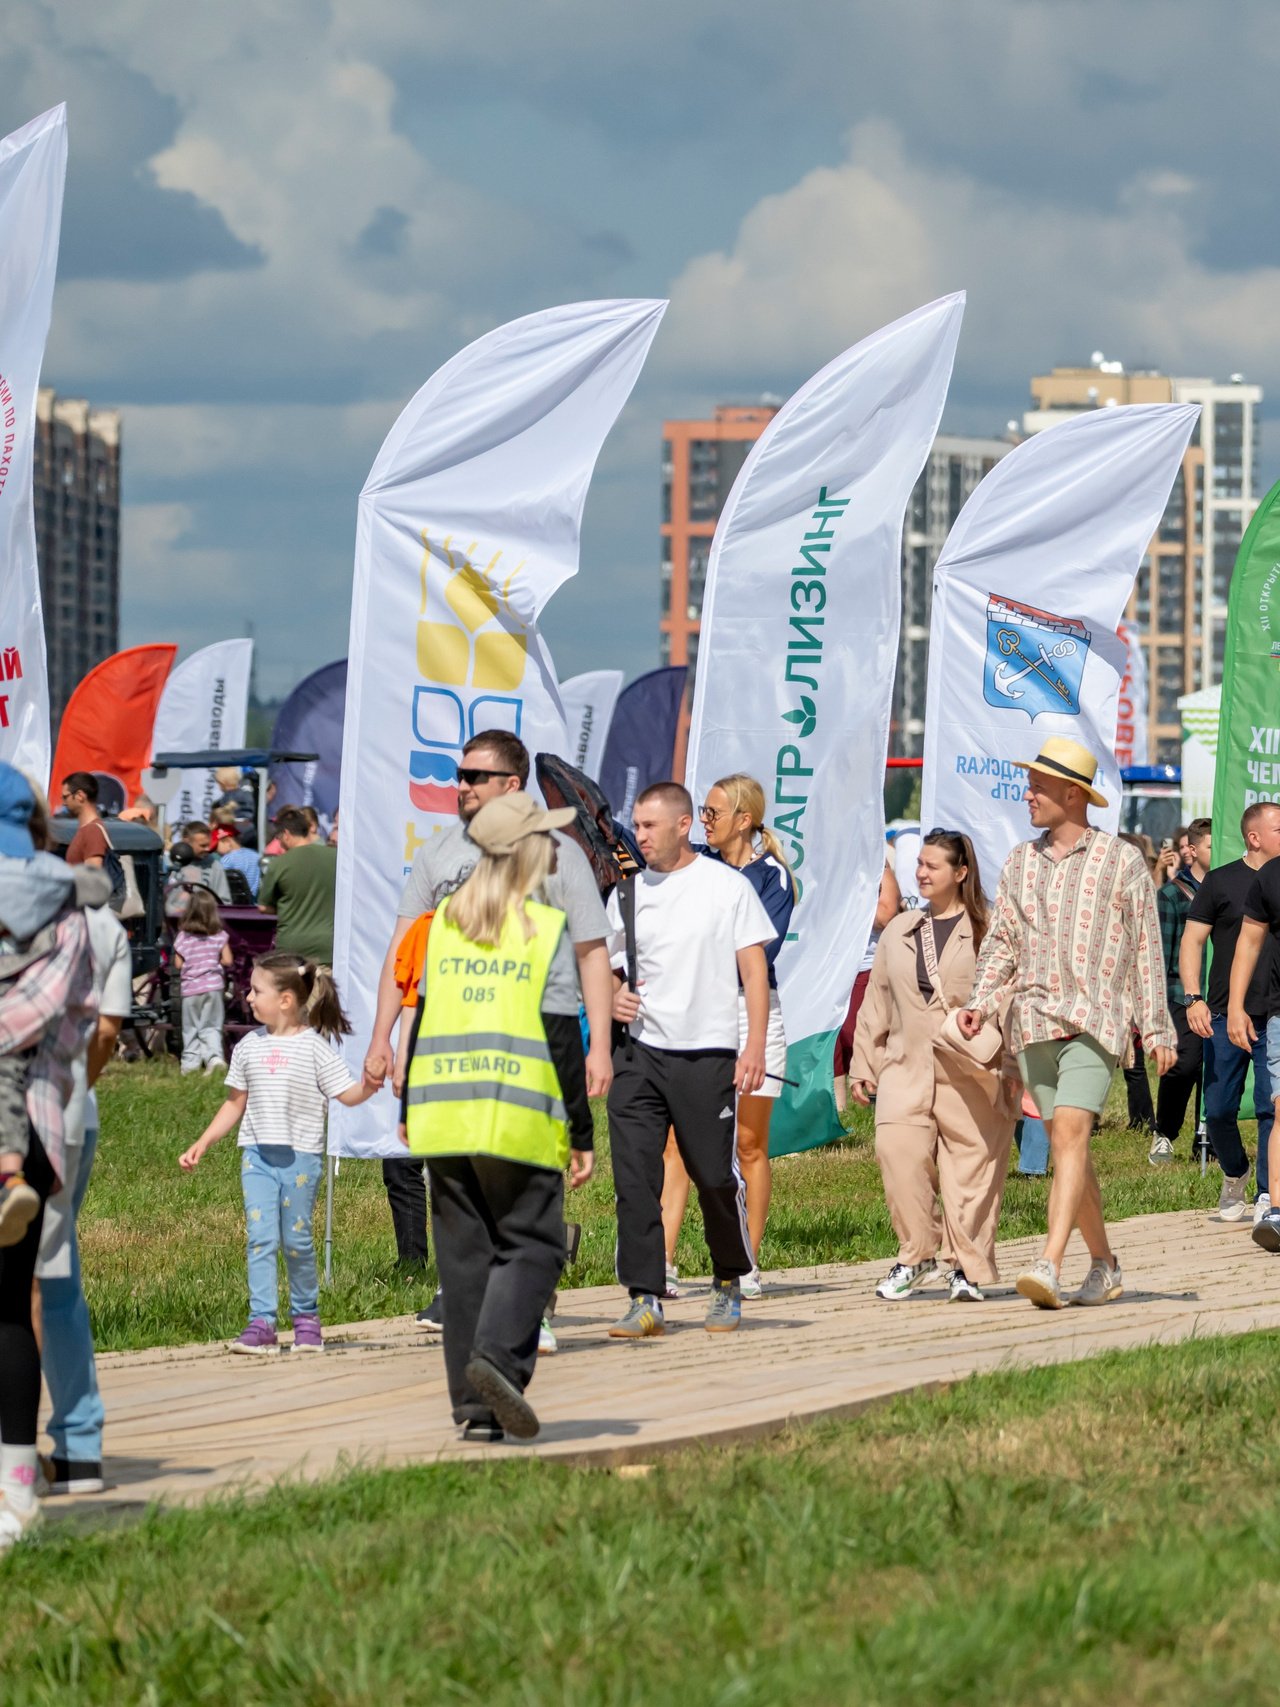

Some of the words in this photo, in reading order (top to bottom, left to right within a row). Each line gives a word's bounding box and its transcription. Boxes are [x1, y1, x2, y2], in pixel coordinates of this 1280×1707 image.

[5, 406, 15, 428] ПО
[0, 433, 15, 495] ПАХОТ
[784, 486, 851, 691] ЛИЗИНГ
[439, 957, 532, 983] СТЮАРД
[462, 986, 495, 1003] 085
[434, 1056, 521, 1076] STEWARD
